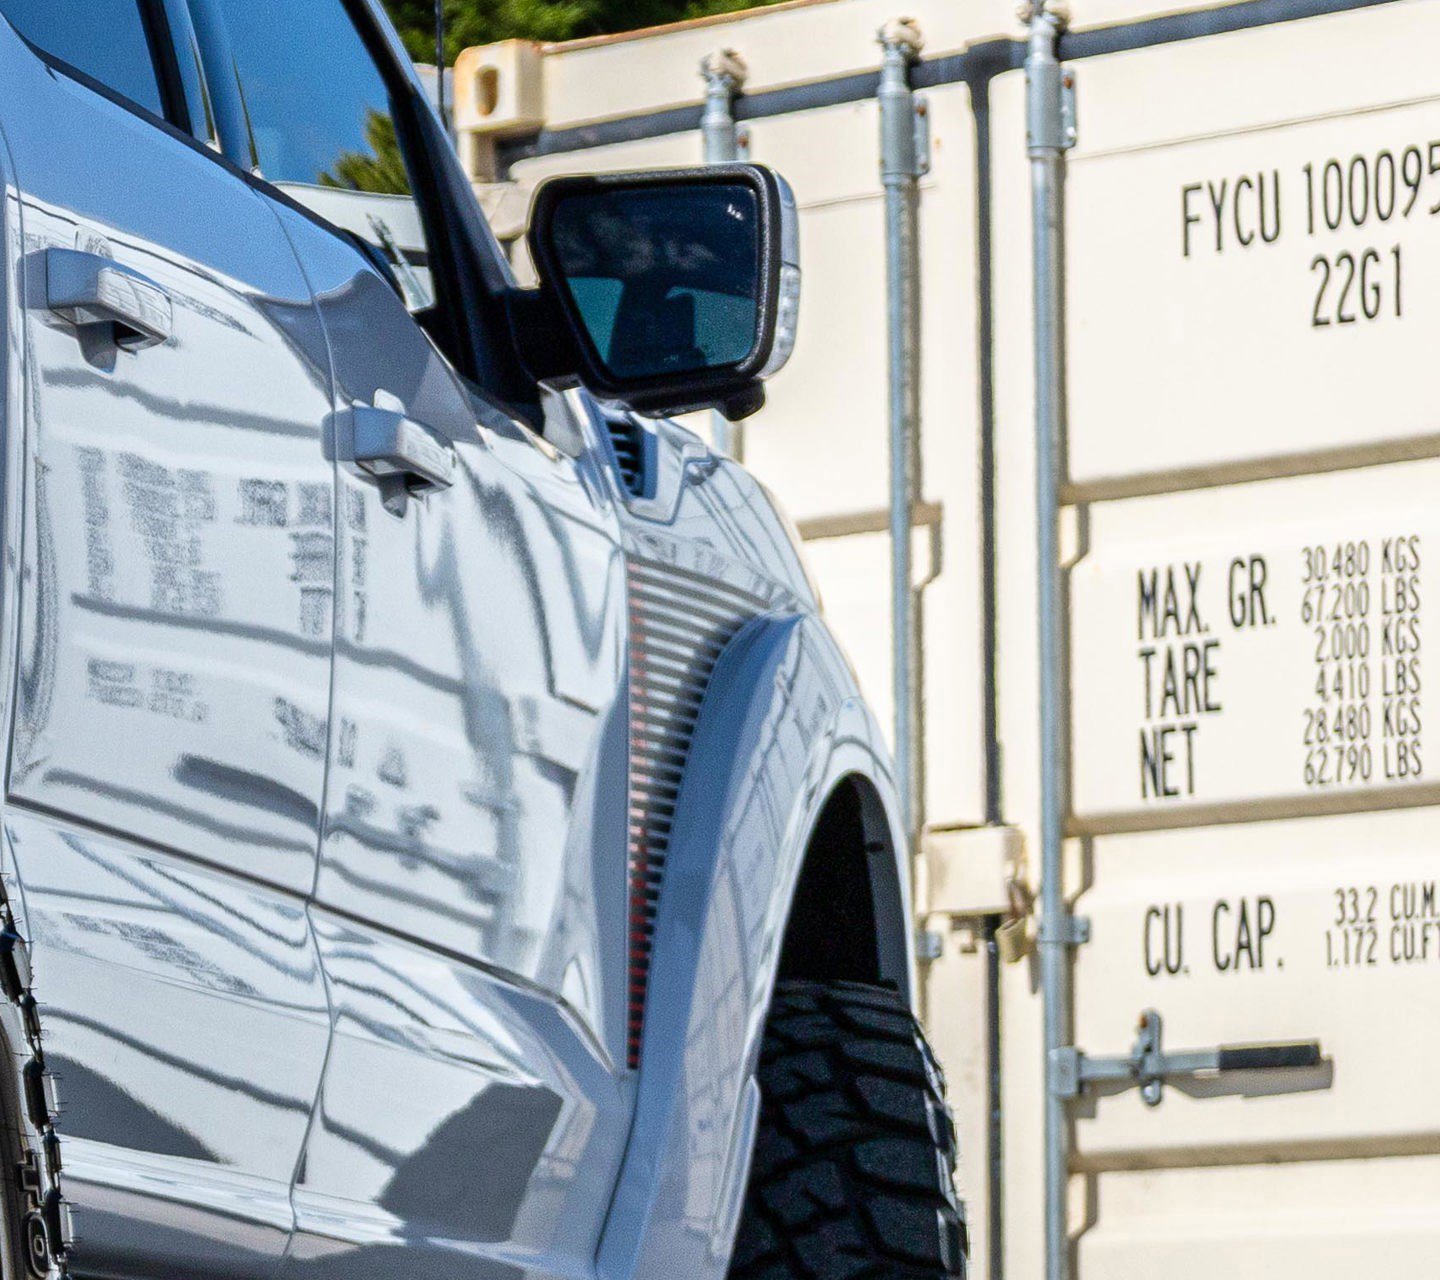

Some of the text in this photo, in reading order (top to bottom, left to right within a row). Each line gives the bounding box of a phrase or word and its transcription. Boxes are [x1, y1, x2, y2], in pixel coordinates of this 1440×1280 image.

[1182, 168, 1282, 257] FYCU
[1310, 242, 1401, 327] 22G1
[1382, 533, 1421, 573] KGS
[1137, 552, 1277, 641] MAX. GR.
[1382, 574, 1421, 615] LBS
[1382, 615, 1421, 656] KGS
[1138, 637, 1222, 720] TARE
[1382, 656, 1421, 697] LBS
[1383, 696, 1422, 738] KGS
[1139, 722, 1200, 799] NET
[1383, 737, 1423, 779] LBS
[1144, 894, 1285, 977] CU. CAP.
